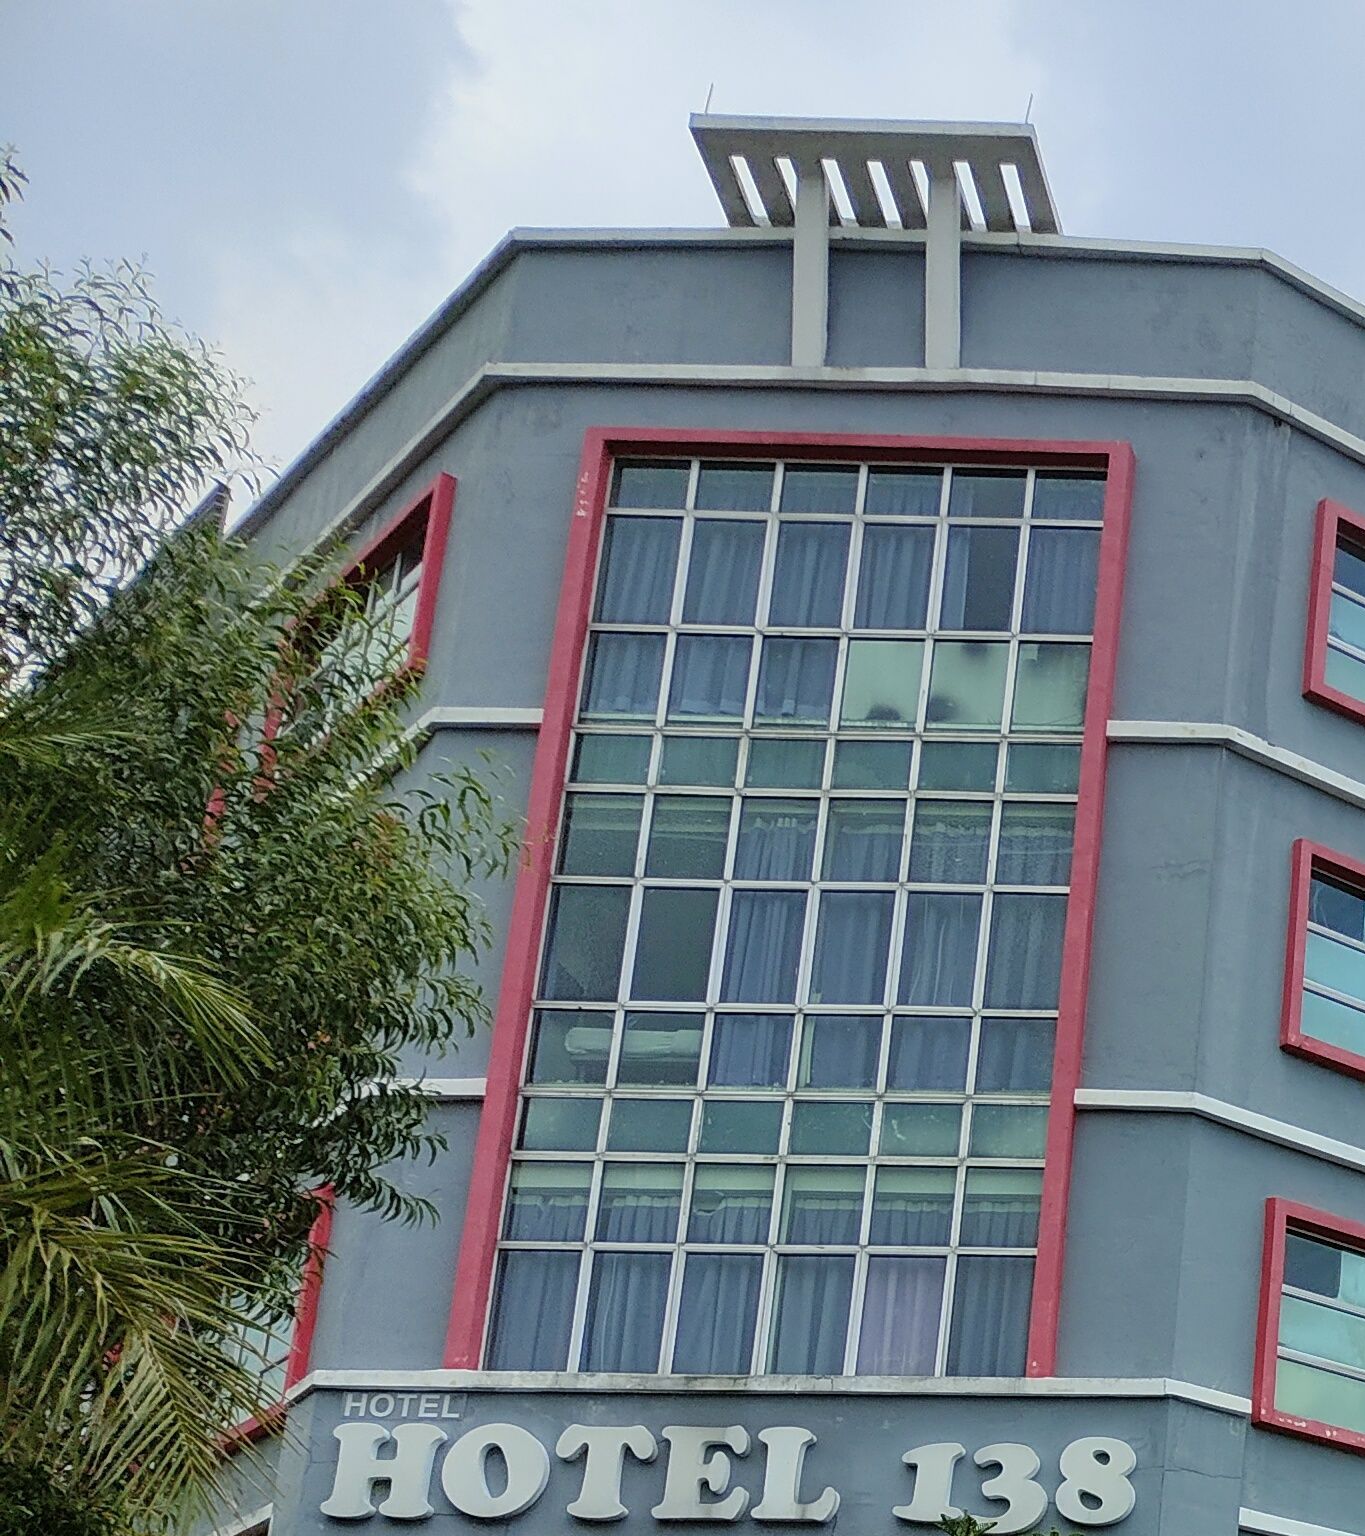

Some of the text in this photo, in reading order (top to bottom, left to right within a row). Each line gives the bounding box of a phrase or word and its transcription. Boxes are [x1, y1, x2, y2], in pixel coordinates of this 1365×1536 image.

[343, 1392, 461, 1419] HOTEL
[320, 1422, 1137, 1536] HOTEL 138
